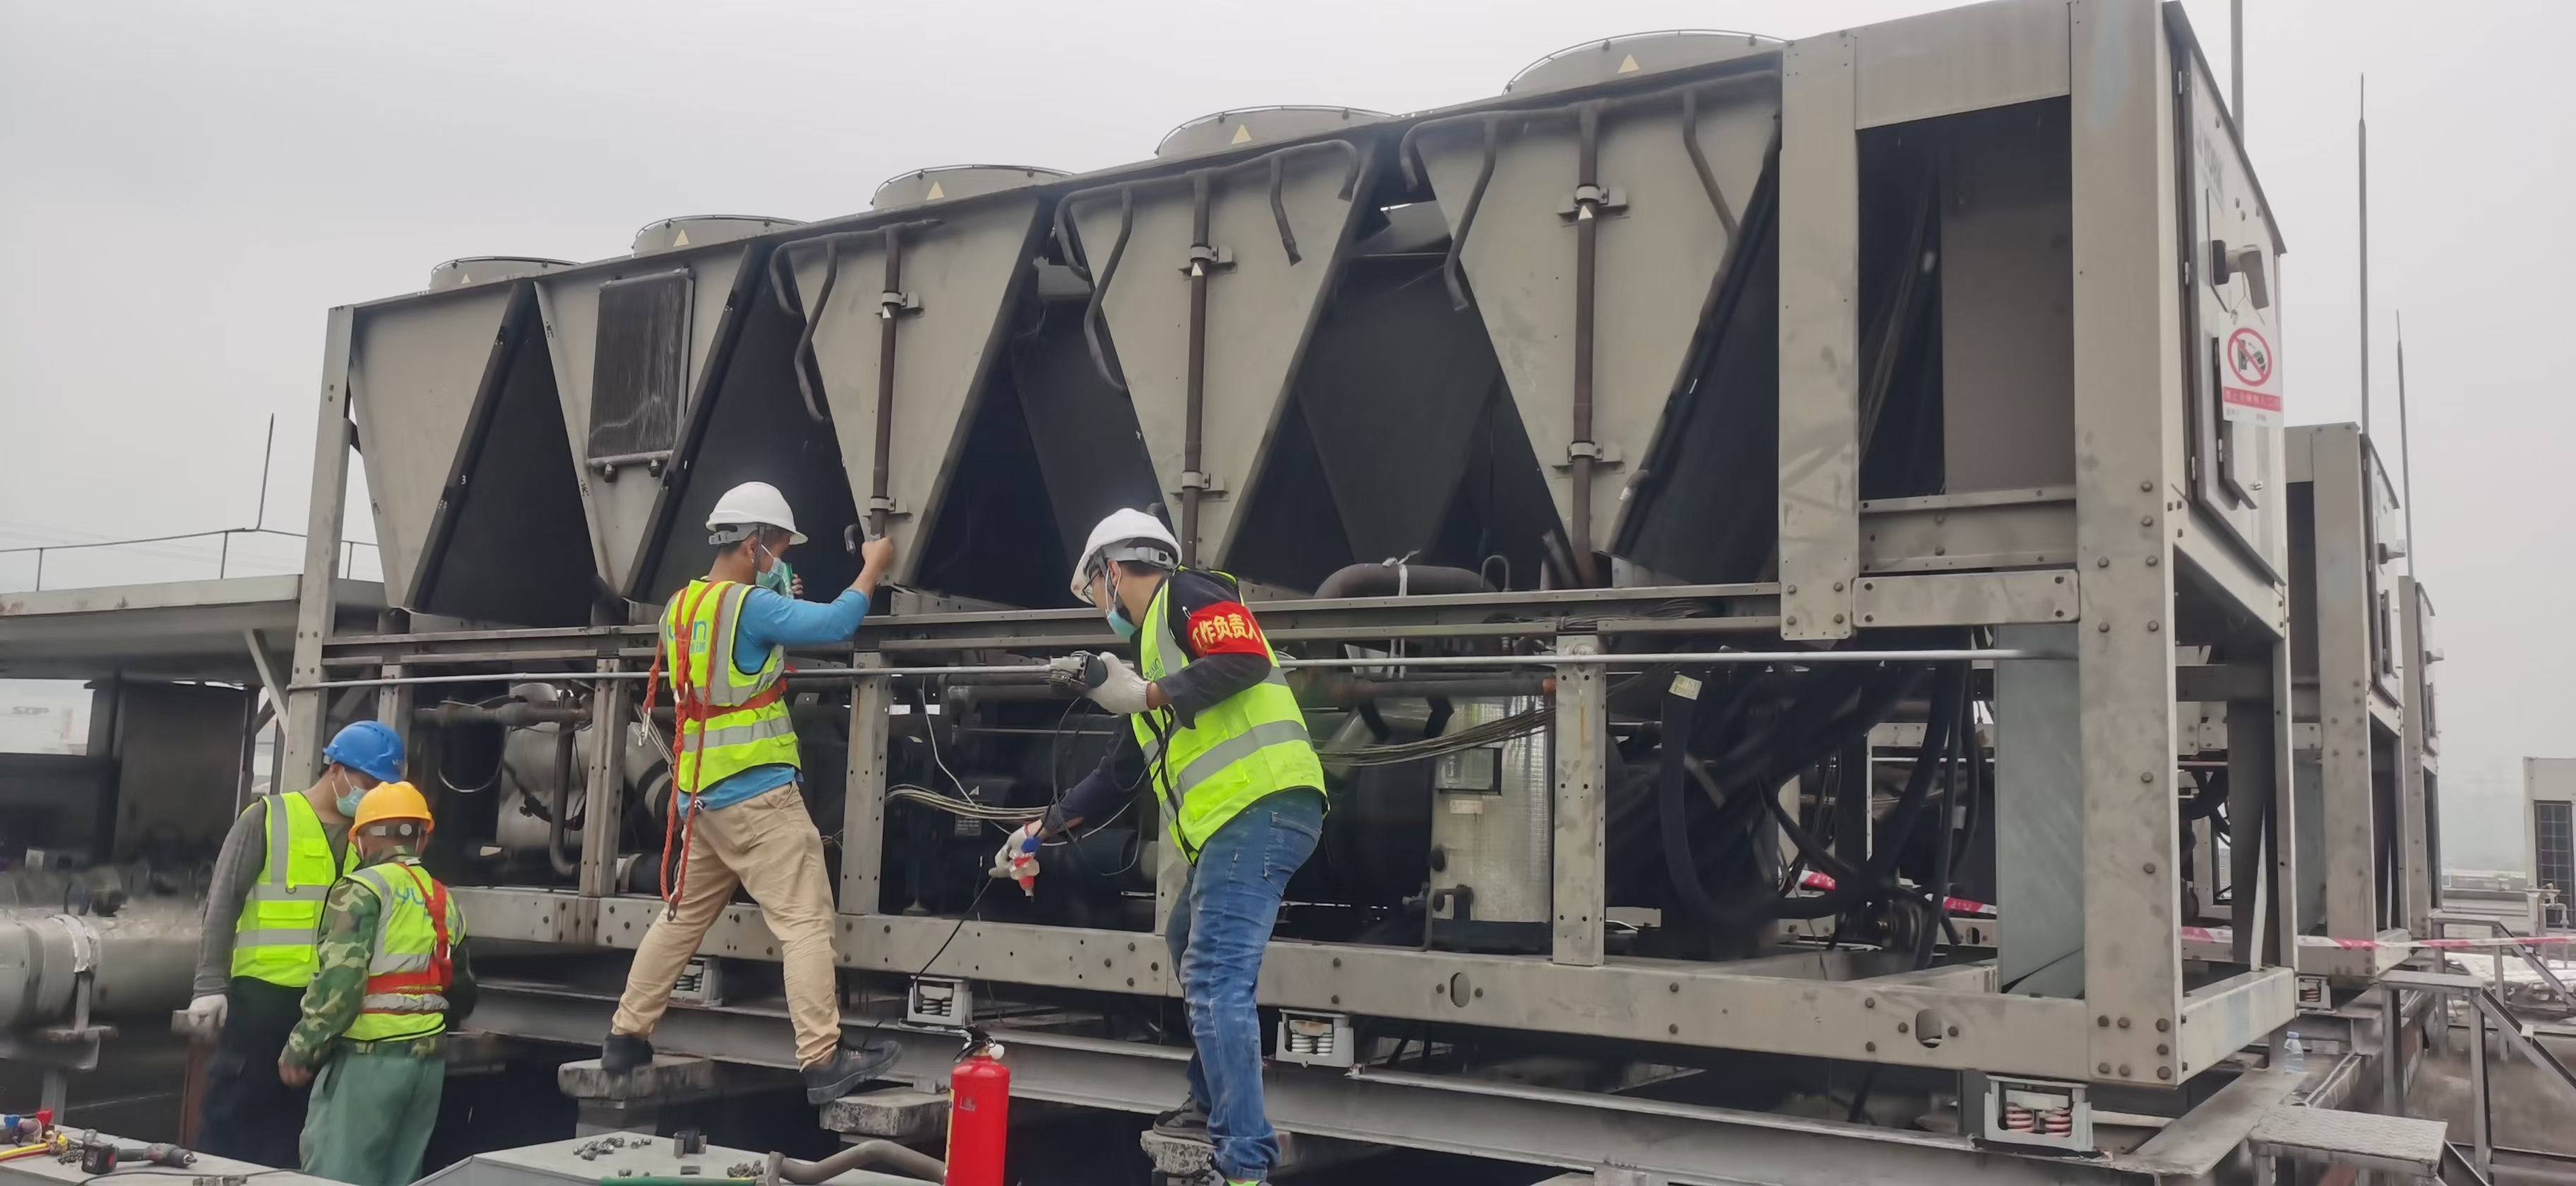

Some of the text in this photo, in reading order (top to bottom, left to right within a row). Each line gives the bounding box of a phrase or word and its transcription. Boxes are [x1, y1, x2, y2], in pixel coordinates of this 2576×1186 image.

[1192, 613, 1260, 649] 工作负责人
